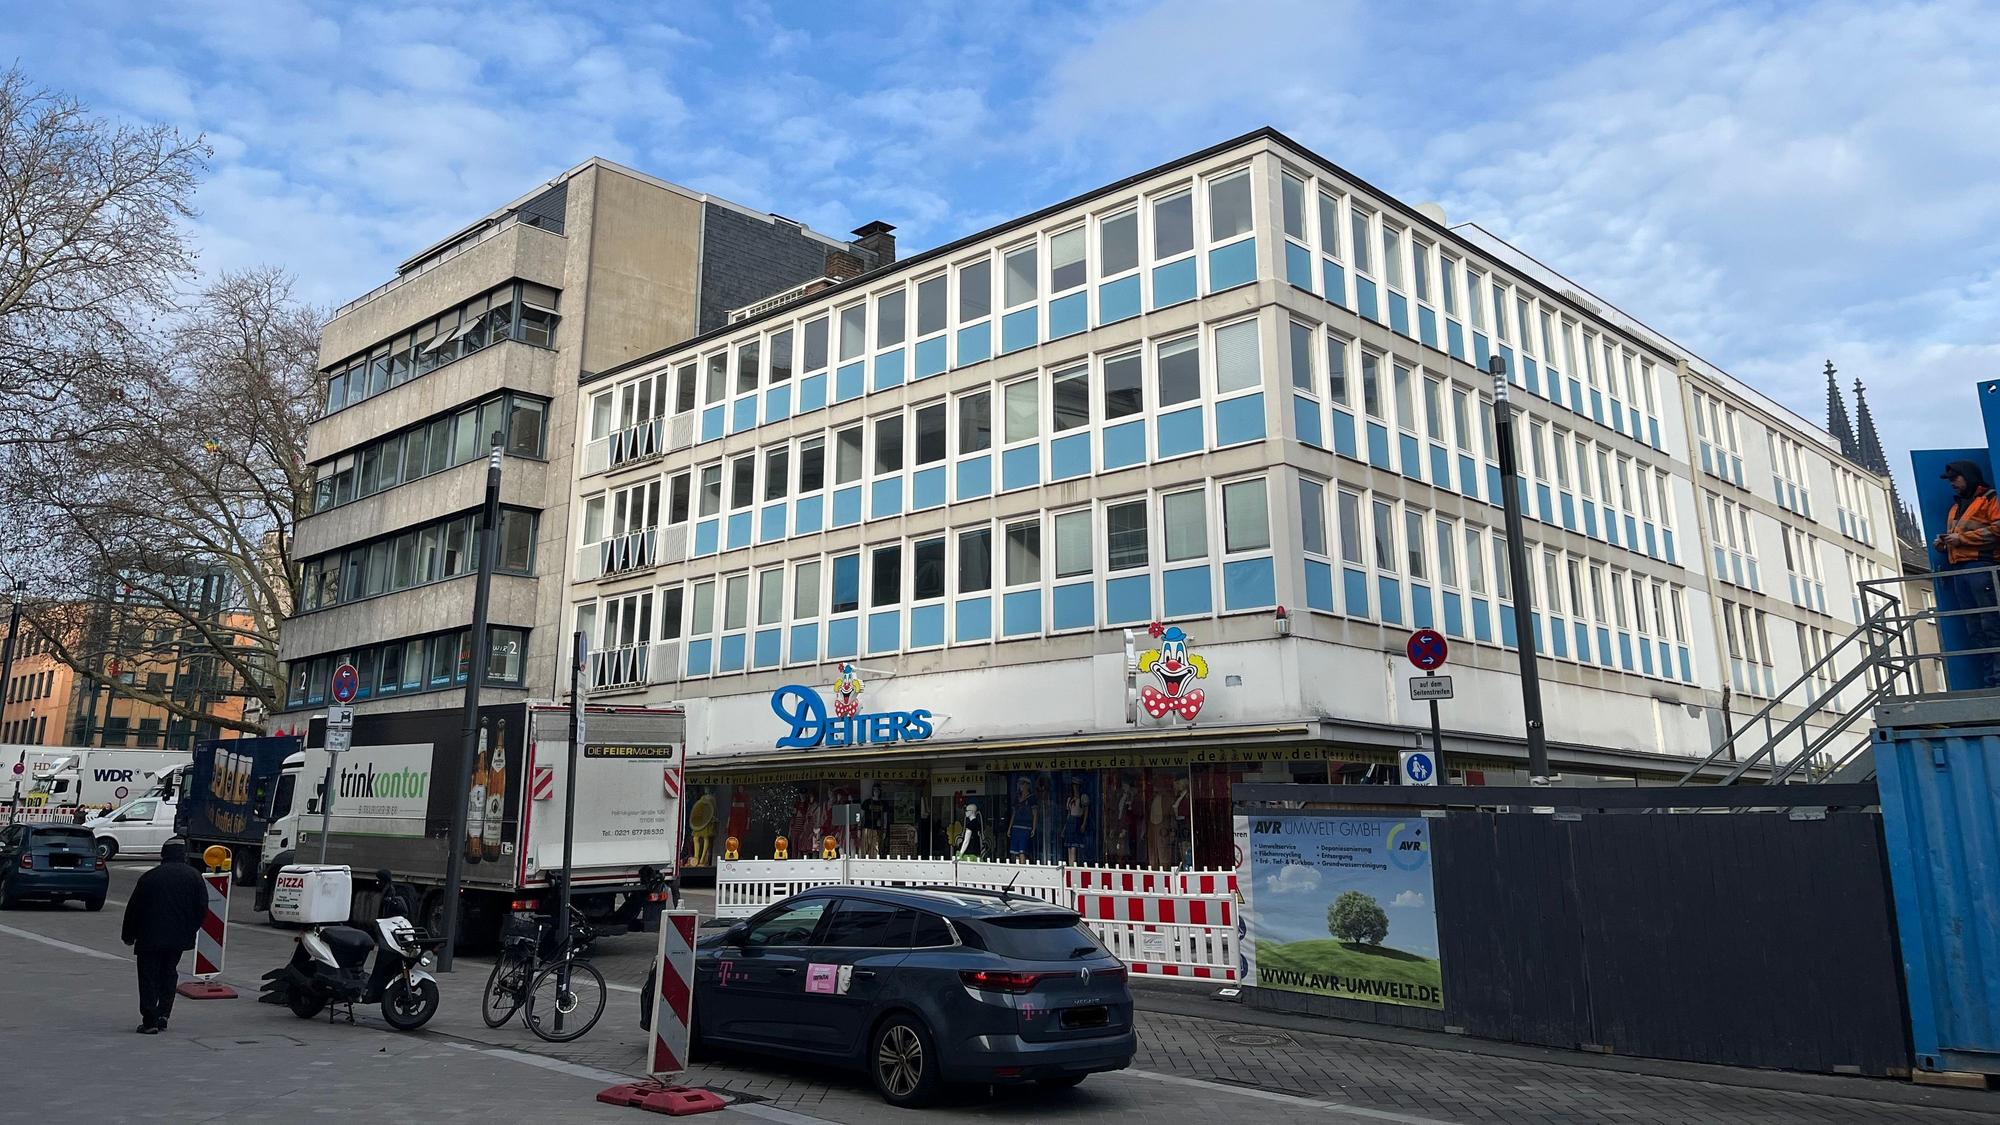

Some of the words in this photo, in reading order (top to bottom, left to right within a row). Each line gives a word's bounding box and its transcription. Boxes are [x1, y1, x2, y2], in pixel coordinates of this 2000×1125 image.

[509, 641, 518, 655] 2
[1431, 680, 1442, 688] dem
[1413, 688, 1450, 696] Seitenstreifen
[587, 747, 601, 755] DIE
[603, 747, 670, 756] FEIERMACHER
[94, 768, 133, 782] WDR
[340, 762, 428, 799] trinkkontor
[1253, 820, 1283, 835] AVR
[1284, 821, 1336, 836] UMWELT
[1338, 822, 1381, 837] GMBH
[1399, 841, 1421, 851] AVR
[1321, 853, 1353, 861] Entsorgung
[277, 878, 304, 888] PIZZA
[1260, 967, 1440, 1004] WWW.AVR-UMWELT.DE
